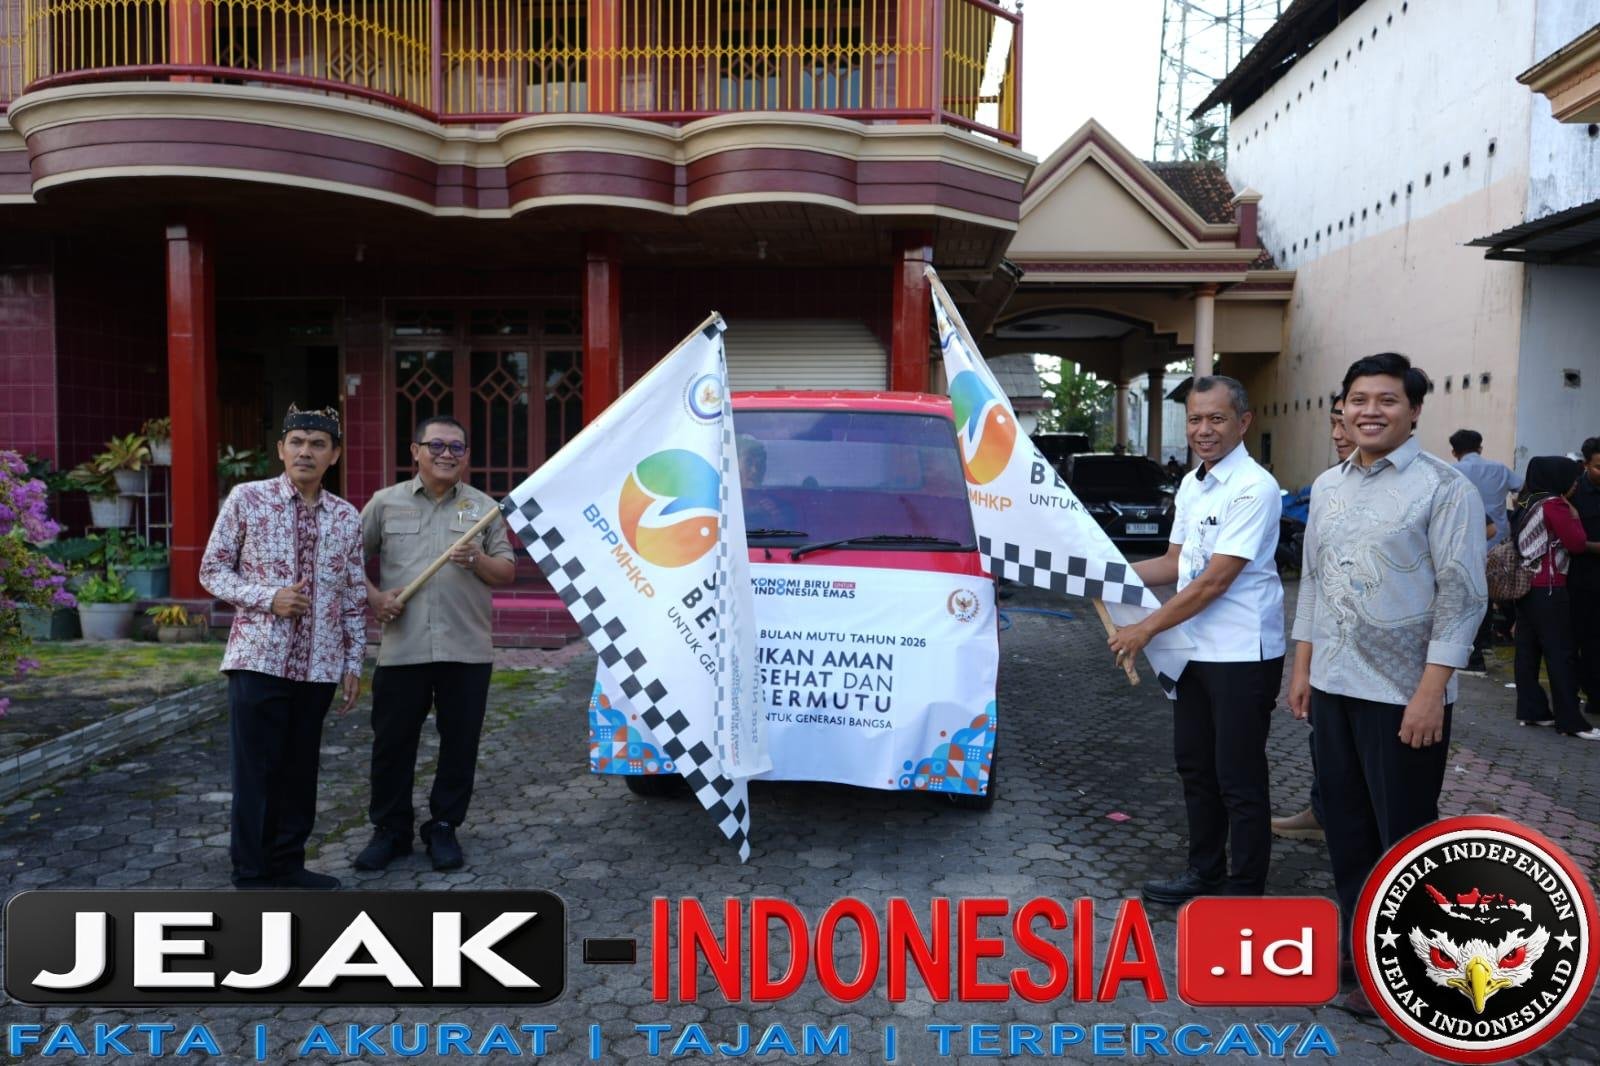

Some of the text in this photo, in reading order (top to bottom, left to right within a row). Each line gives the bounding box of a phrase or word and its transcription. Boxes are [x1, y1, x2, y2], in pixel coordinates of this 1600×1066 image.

[1029, 493, 1079, 511] UNTUK
[583, 503, 655, 598] BPPMHKP
[754, 587, 856, 599] INDONESIA EMAS
[804, 580, 830, 589] BIRU
[667, 606, 702, 654] UNTUK
[760, 629, 926, 647] BULAN MUTU TAHUN 2026
[760, 648, 893, 671] IKAN AMAN
[843, 672, 893, 692] DAN
[762, 689, 891, 713] ERMUTU
[796, 714, 846, 725] GENERASI
[849, 717, 892, 729] BANGSA
